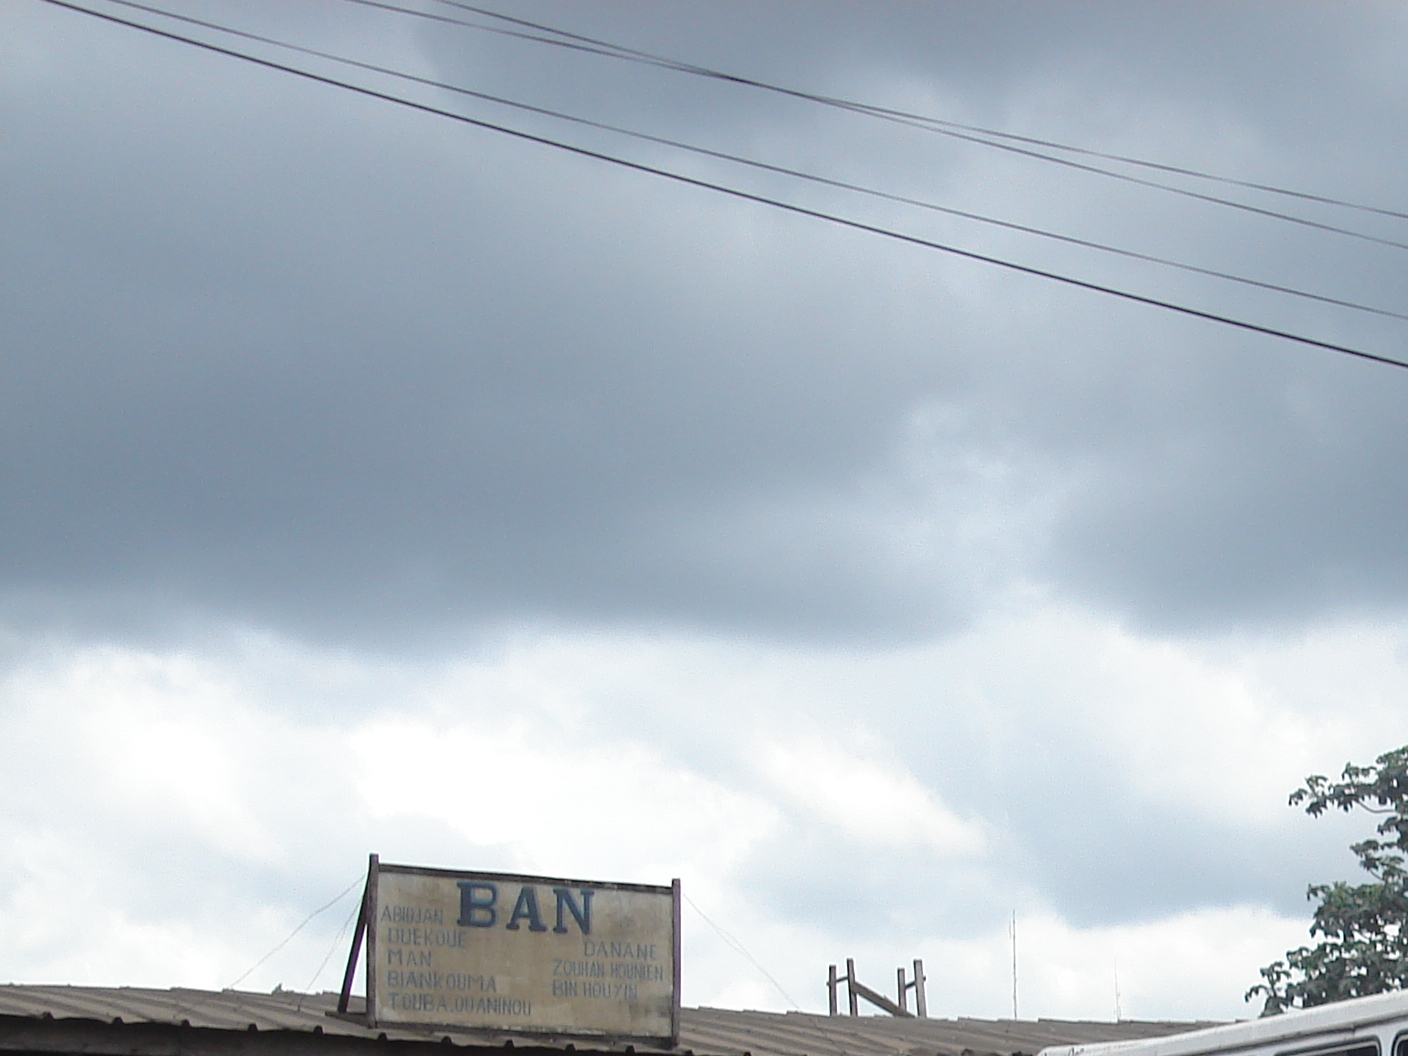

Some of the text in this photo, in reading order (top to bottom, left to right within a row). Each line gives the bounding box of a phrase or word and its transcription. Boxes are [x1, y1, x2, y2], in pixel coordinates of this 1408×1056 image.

[381, 905, 443, 925] ABIDJAN
[456, 881, 595, 936] BAN
[388, 949, 432, 967] MAN
[387, 970, 497, 993] BIANKOUMA
